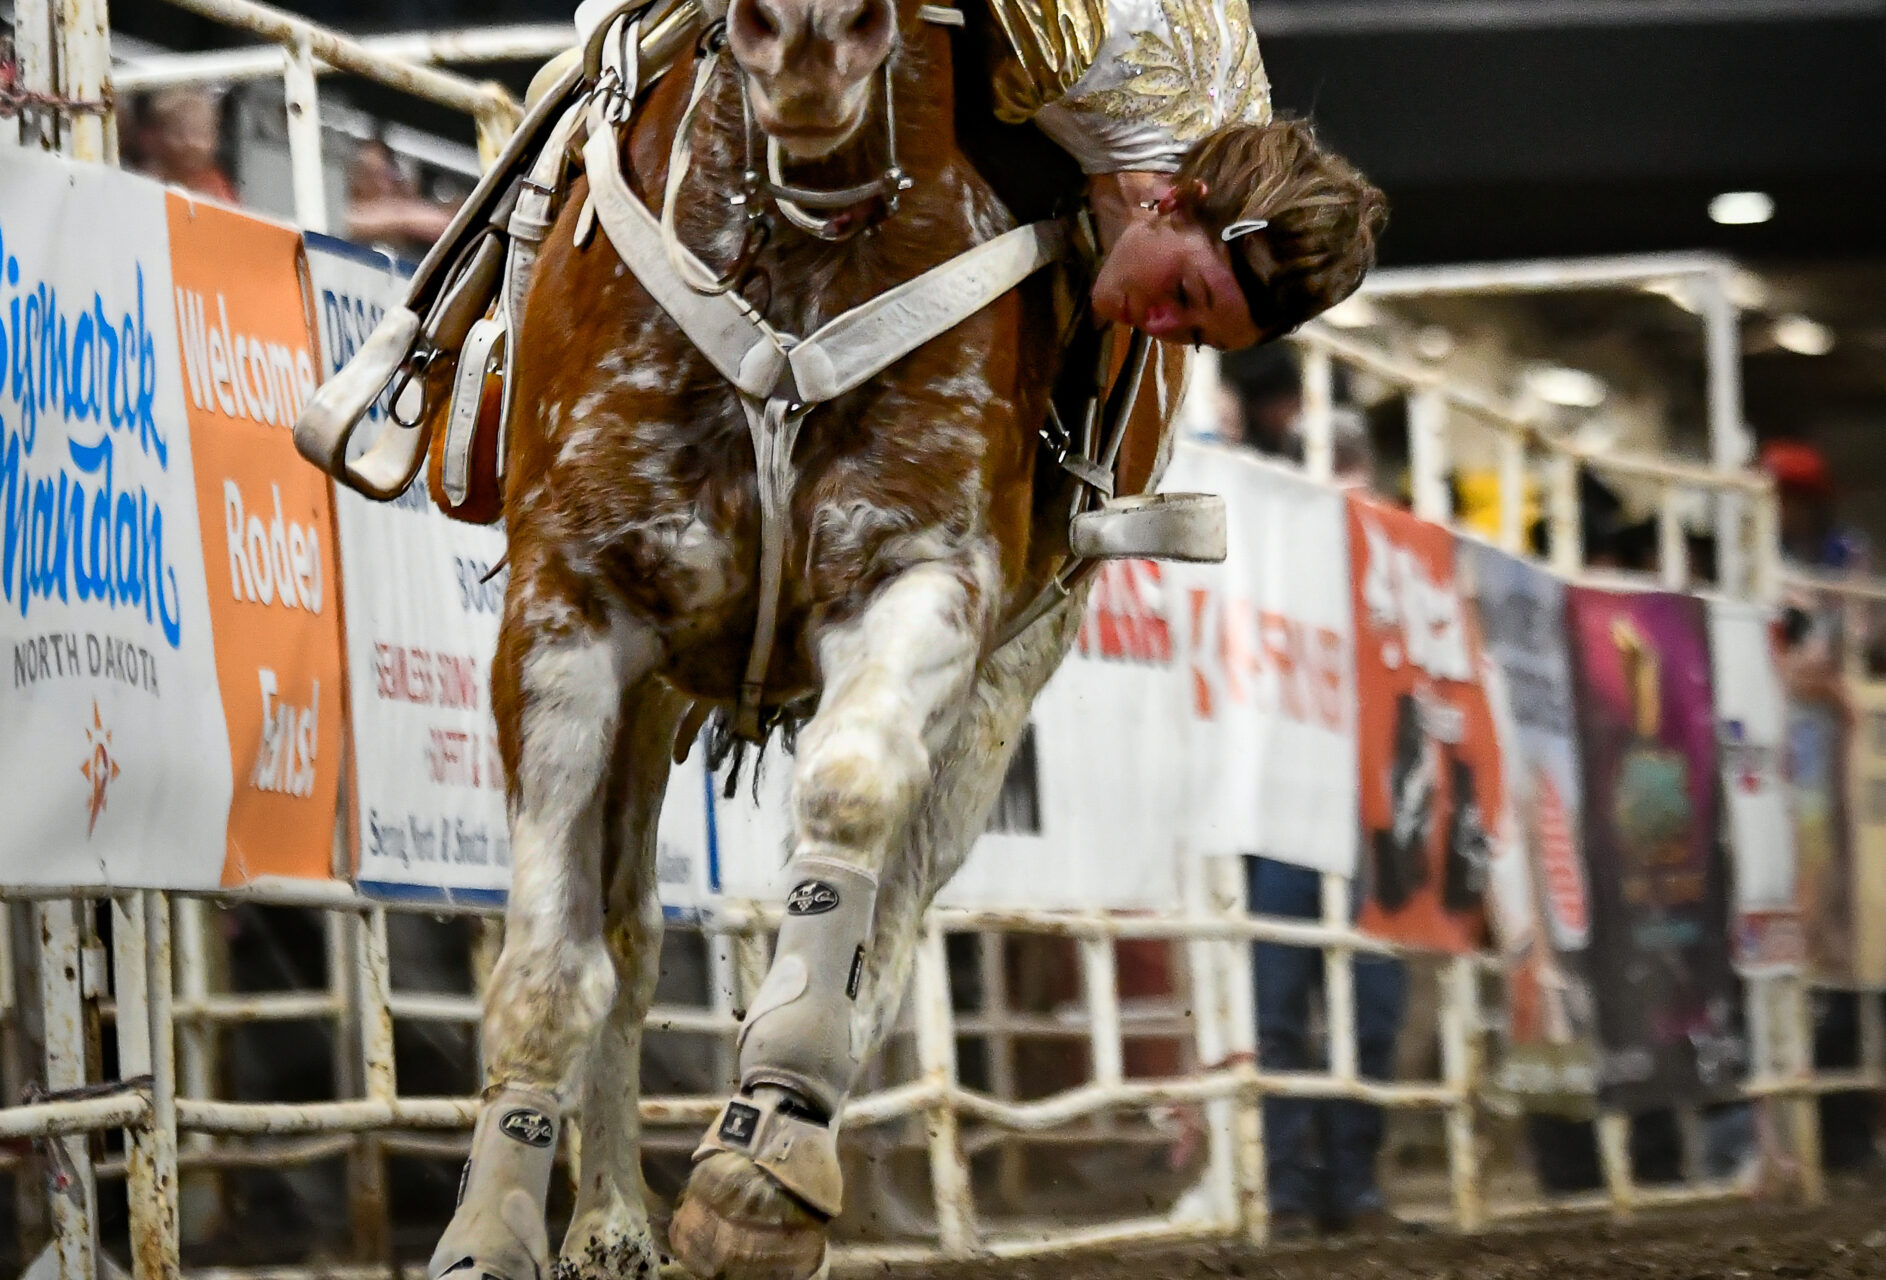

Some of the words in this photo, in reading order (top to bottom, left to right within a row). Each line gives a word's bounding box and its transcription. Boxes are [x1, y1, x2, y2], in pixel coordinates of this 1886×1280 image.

[0, 223, 168, 473] ismarck
[175, 285, 316, 431] Welcome
[223, 477, 323, 616] Rodeo
[14, 632, 80, 691] NORTH
[86, 631, 161, 699] DAKOTA
